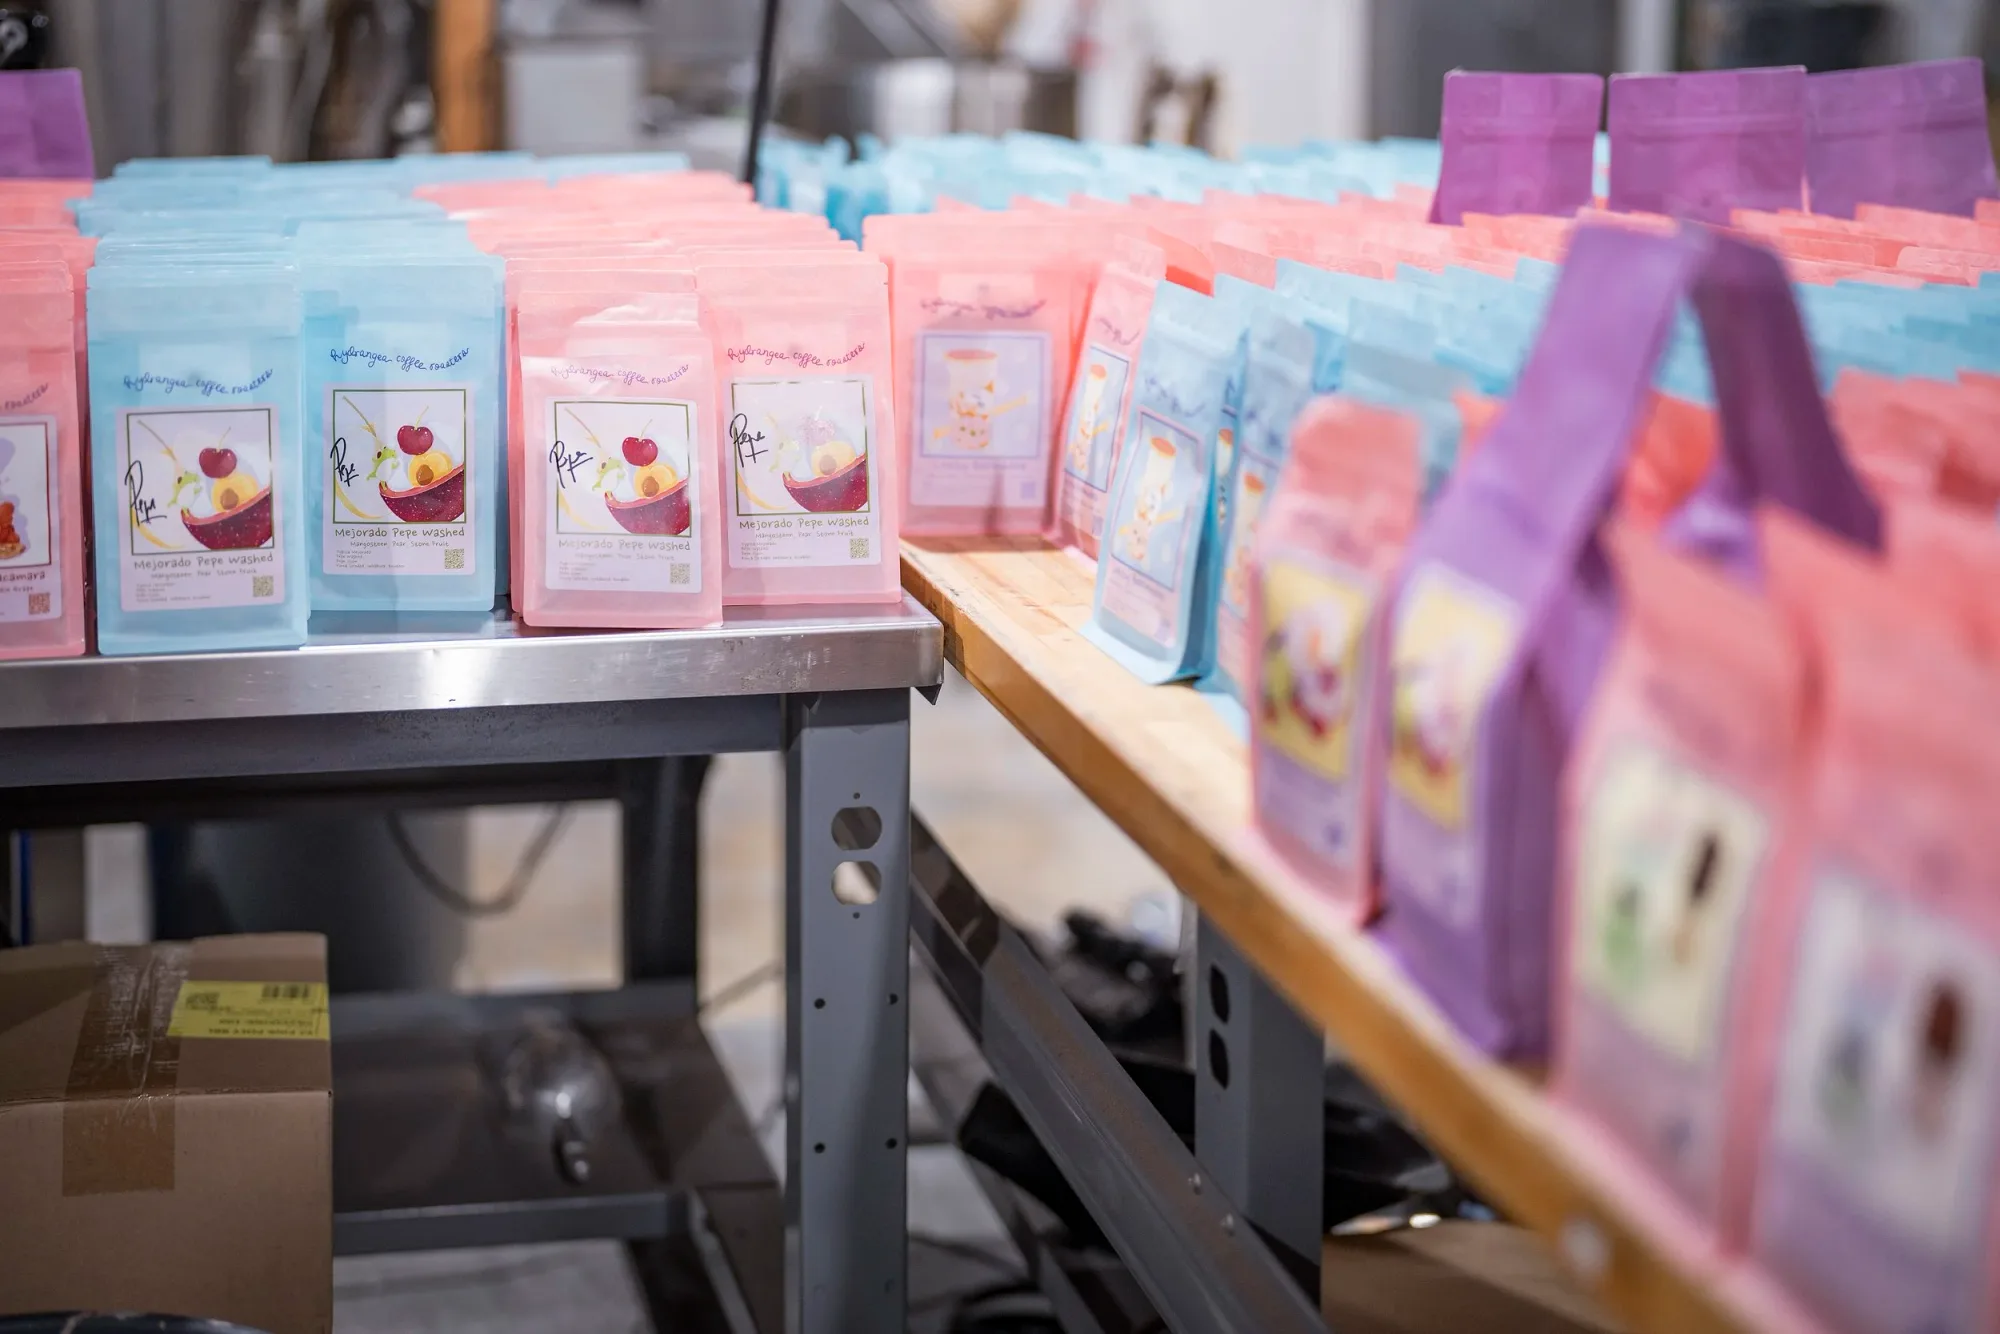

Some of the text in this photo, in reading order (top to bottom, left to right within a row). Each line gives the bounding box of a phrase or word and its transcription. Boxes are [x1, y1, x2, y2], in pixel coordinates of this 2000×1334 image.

[330, 346, 469, 373] hydrangea coffee roasters
[727, 342, 865, 368] hydrangea coffee roasters
[617, 369, 649, 386] coffee
[650, 364, 689, 385] roasters
[195, 378, 228, 397] coffee
[335, 526, 465, 539] Mejorado Pepe Washed
[739, 516, 869, 531] Mejorado Pepe Washed
[558, 539, 691, 551] Mejorado Pepe Washed
[134, 551, 274, 571] Mejorado Pepe Washed
